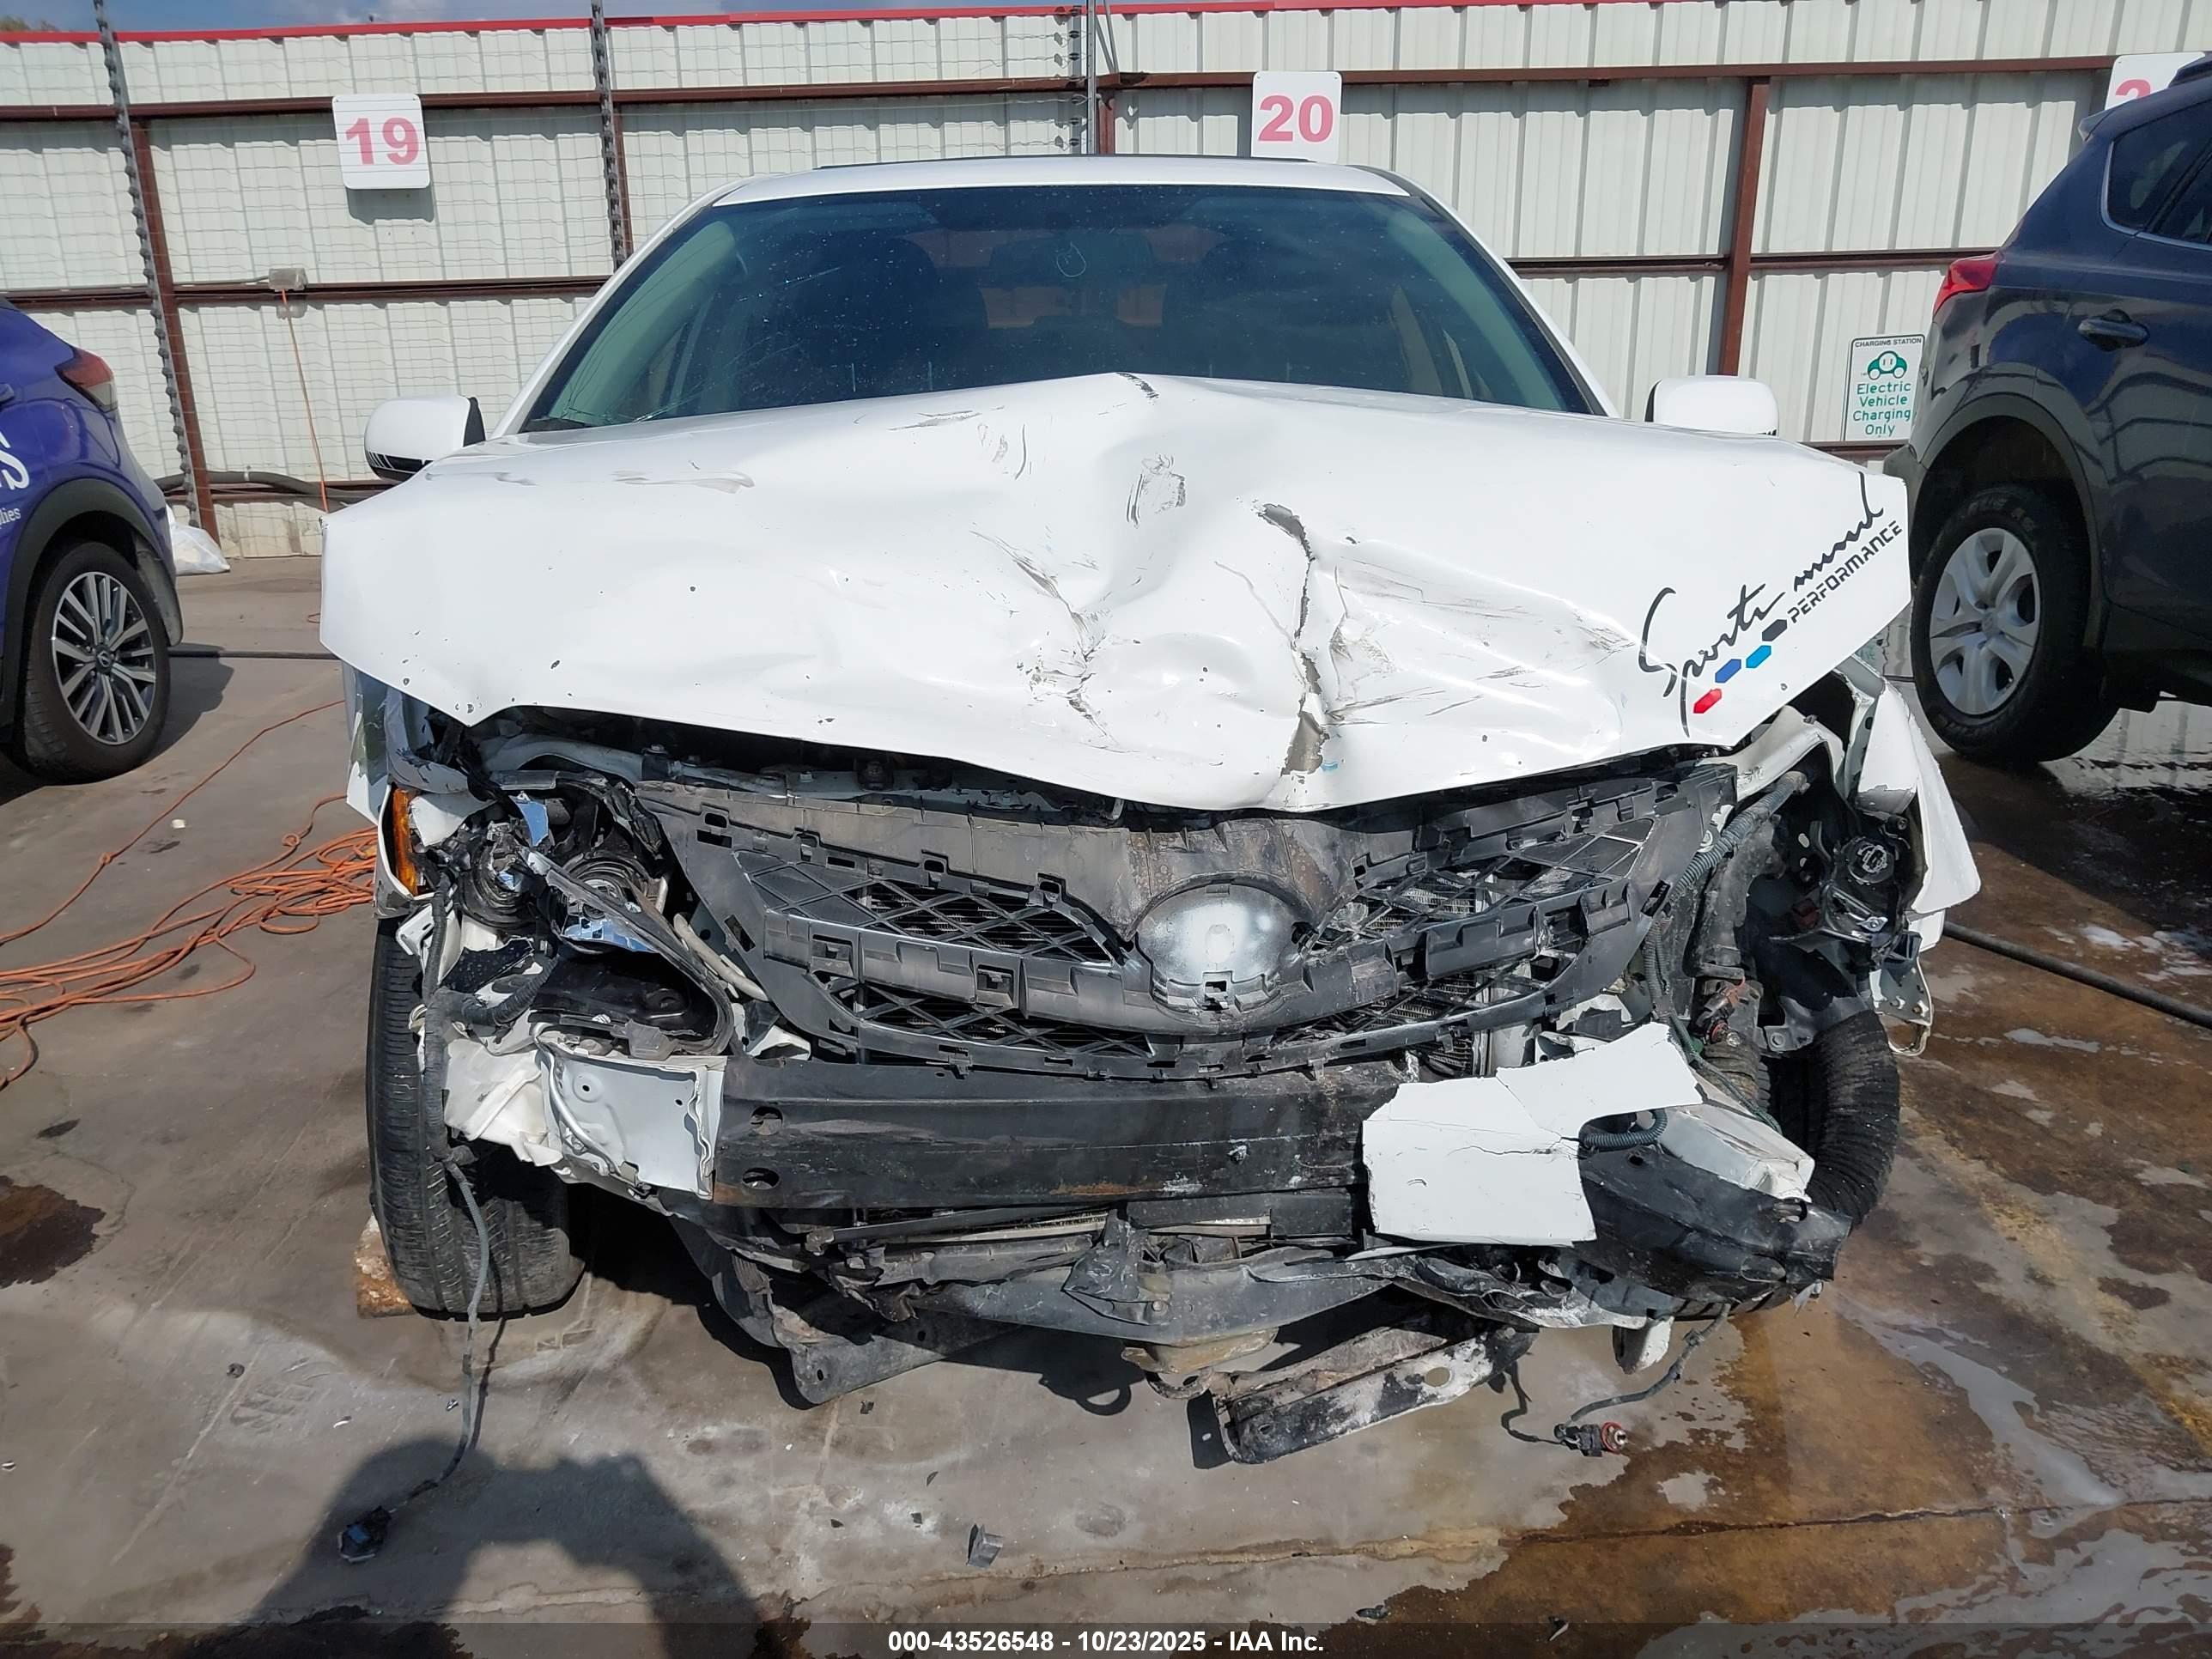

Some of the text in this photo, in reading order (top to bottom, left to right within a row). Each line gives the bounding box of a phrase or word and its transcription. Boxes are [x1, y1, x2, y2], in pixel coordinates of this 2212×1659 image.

[1258, 94, 1334, 143] 20
[345, 117, 419, 165] 19
[1856, 380, 1911, 395] Electric
[1860, 394, 1908, 407] Vehicle
[1852, 408, 1911, 423] Charging
[1865, 423, 1896, 437] Only
[1787, 520, 1903, 624] PERFORMANCE
